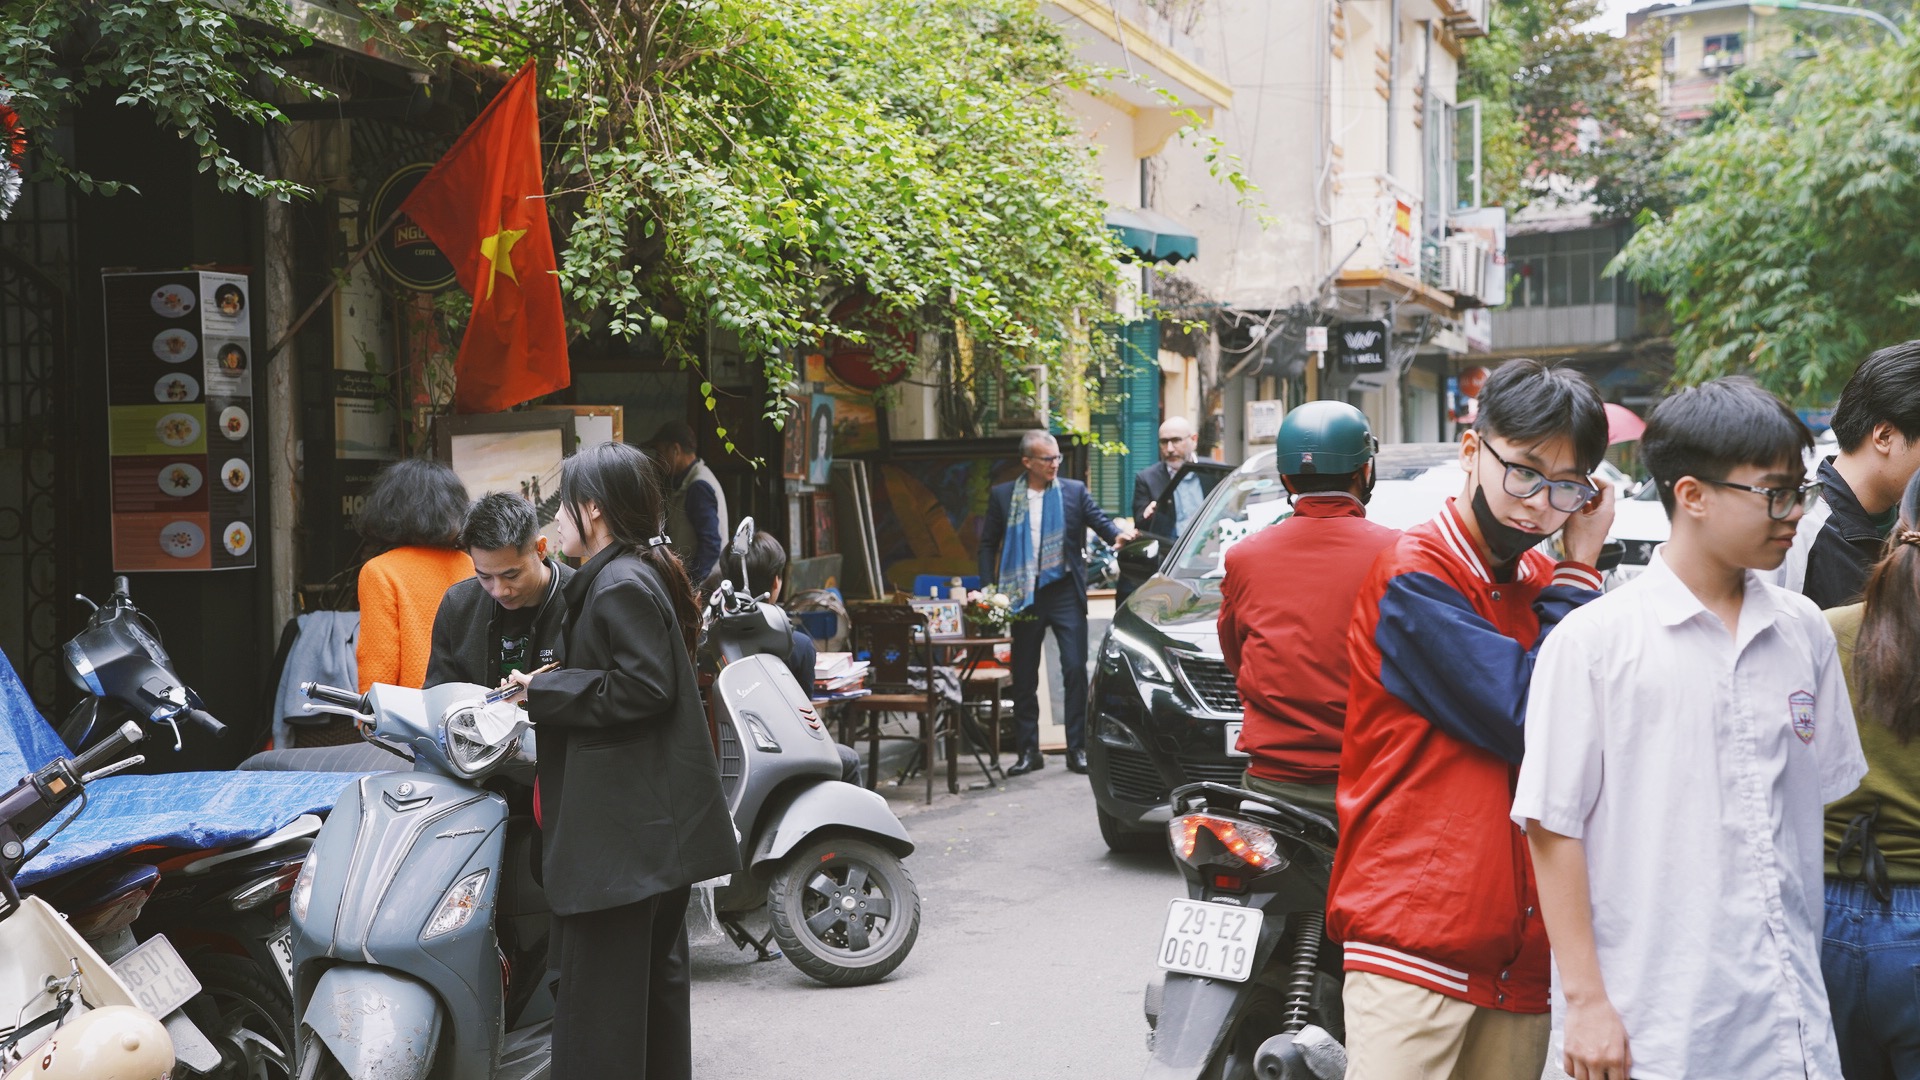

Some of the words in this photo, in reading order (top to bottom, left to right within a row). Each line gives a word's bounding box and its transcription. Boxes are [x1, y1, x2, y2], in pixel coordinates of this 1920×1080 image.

[1357, 353, 1382, 364] WELL
[342, 495, 370, 515] HO
[736, 681, 761, 699] Vespa
[1178, 906, 1247, 942] 29-E2
[1164, 937, 1246, 975] 060.19
[140, 967, 190, 1016] 94.49
